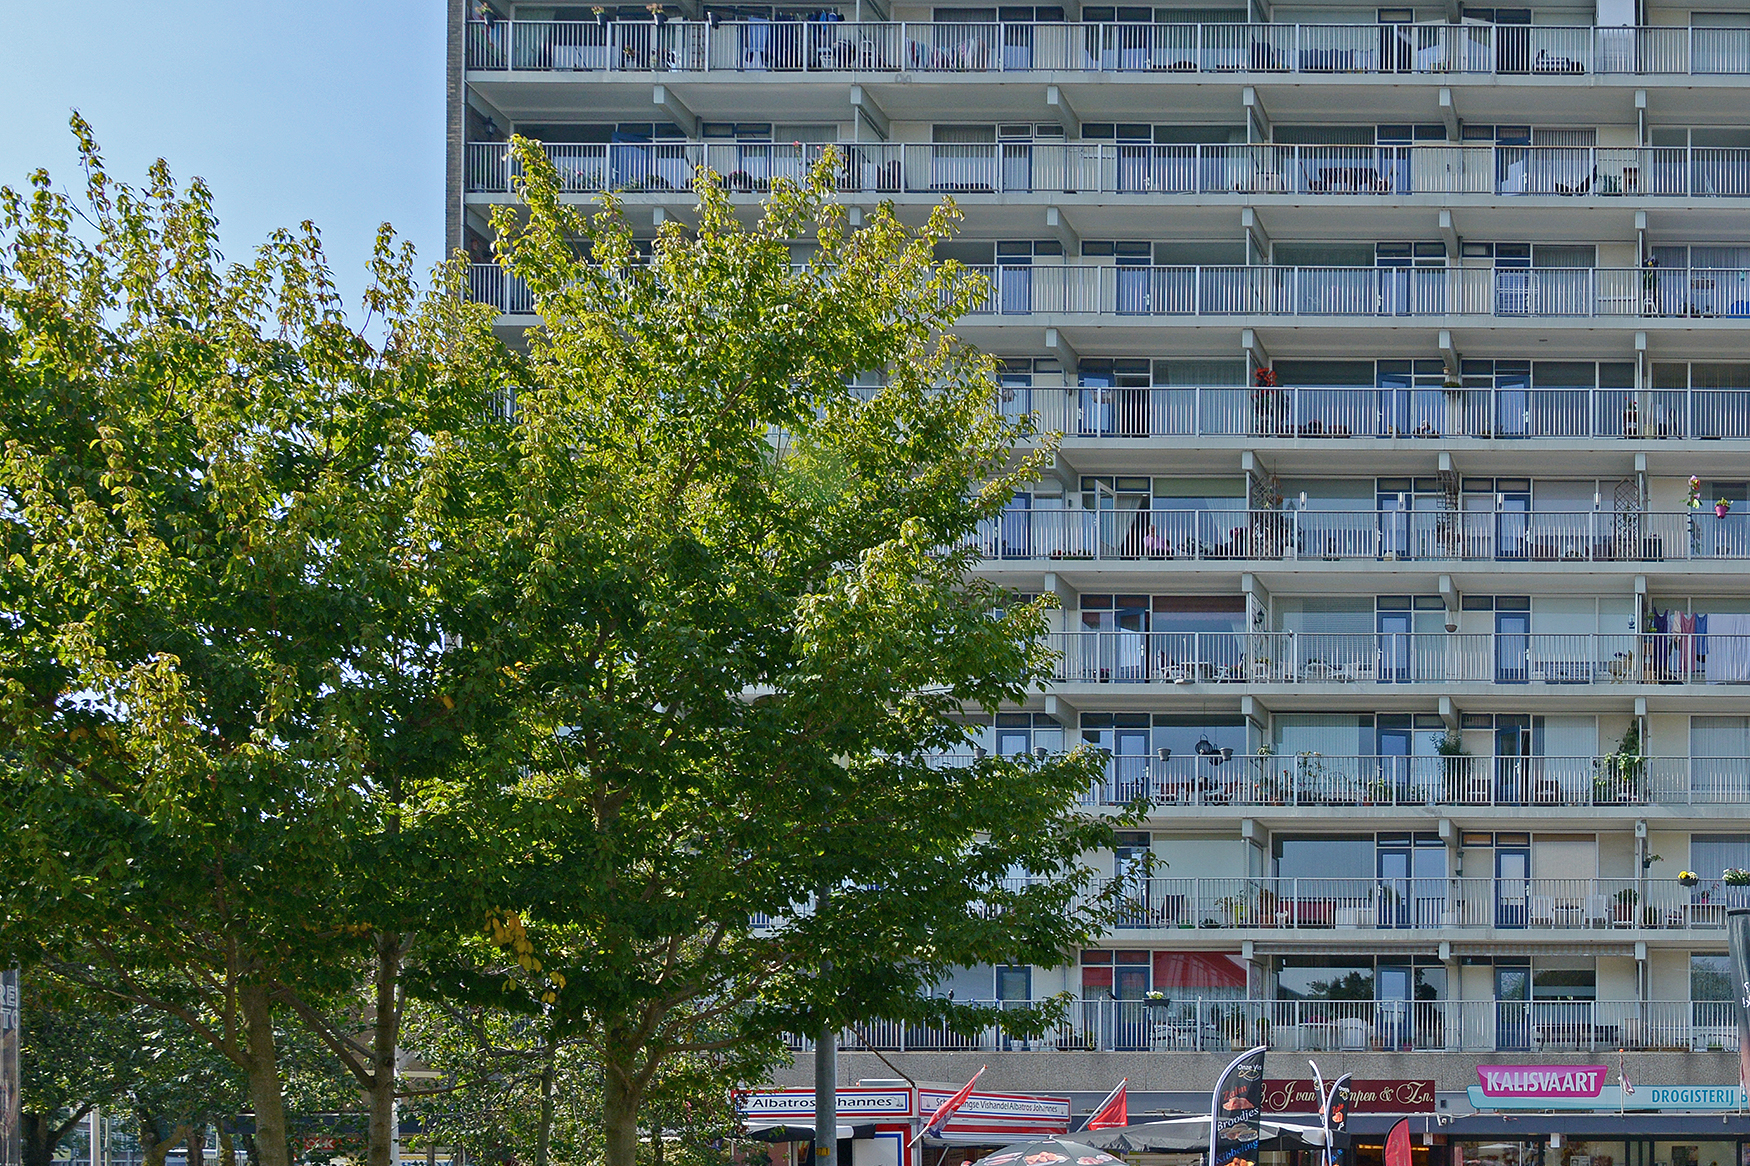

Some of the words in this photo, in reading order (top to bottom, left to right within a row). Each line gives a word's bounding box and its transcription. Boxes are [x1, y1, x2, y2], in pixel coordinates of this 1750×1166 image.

[1487, 1072, 1598, 1092] KALISVAART
[1222, 1085, 1248, 1101] Zalm
[1380, 1086, 1394, 1102] &
[1652, 1089, 1734, 1106] DROGISTERIJ
[752, 1098, 816, 1108] Albatros
[835, 1097, 892, 1107] hannes
[981, 1101, 1009, 1110] Vishandel
[1009, 1102, 1033, 1112] Albatros
[1033, 1103, 1058, 1113] Johannes
[1217, 1107, 1259, 1131] Broodjes
[1216, 1140, 1259, 1164] Kibbeling
